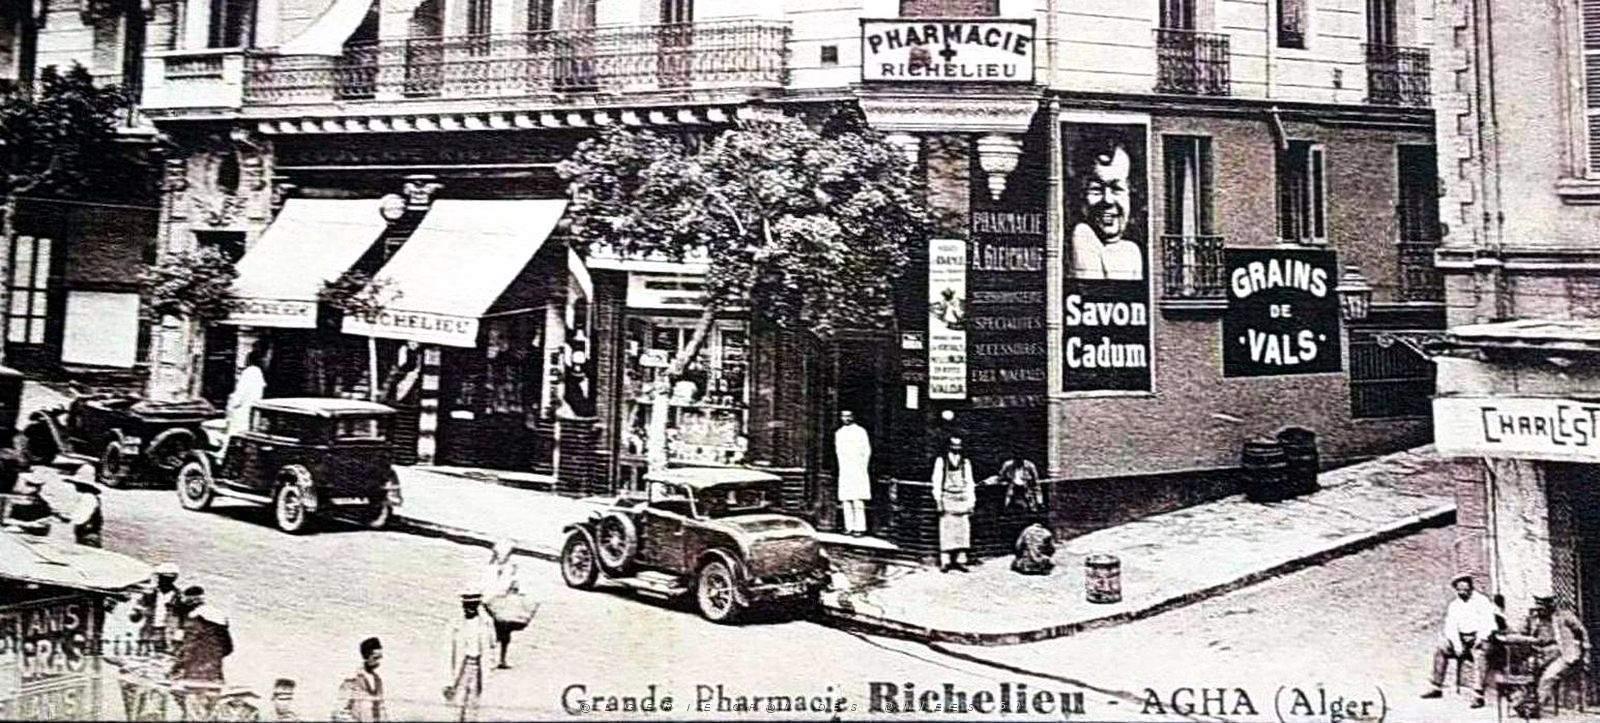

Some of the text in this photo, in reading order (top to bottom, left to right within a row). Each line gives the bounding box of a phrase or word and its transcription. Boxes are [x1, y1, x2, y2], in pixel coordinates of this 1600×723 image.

[867, 23, 1030, 56] PHARMACIE
[881, 63, 1017, 78] RICHELIEU
[973, 211, 1045, 235] PHARMACIE
[1231, 259, 1327, 298] GRAINS
[1066, 294, 1147, 326] Savon
[1270, 304, 1291, 318] DE
[1066, 336, 1147, 368] Cadum
[1481, 405, 1600, 446] CHARLEST
[27, 604, 80, 635] ANIS
